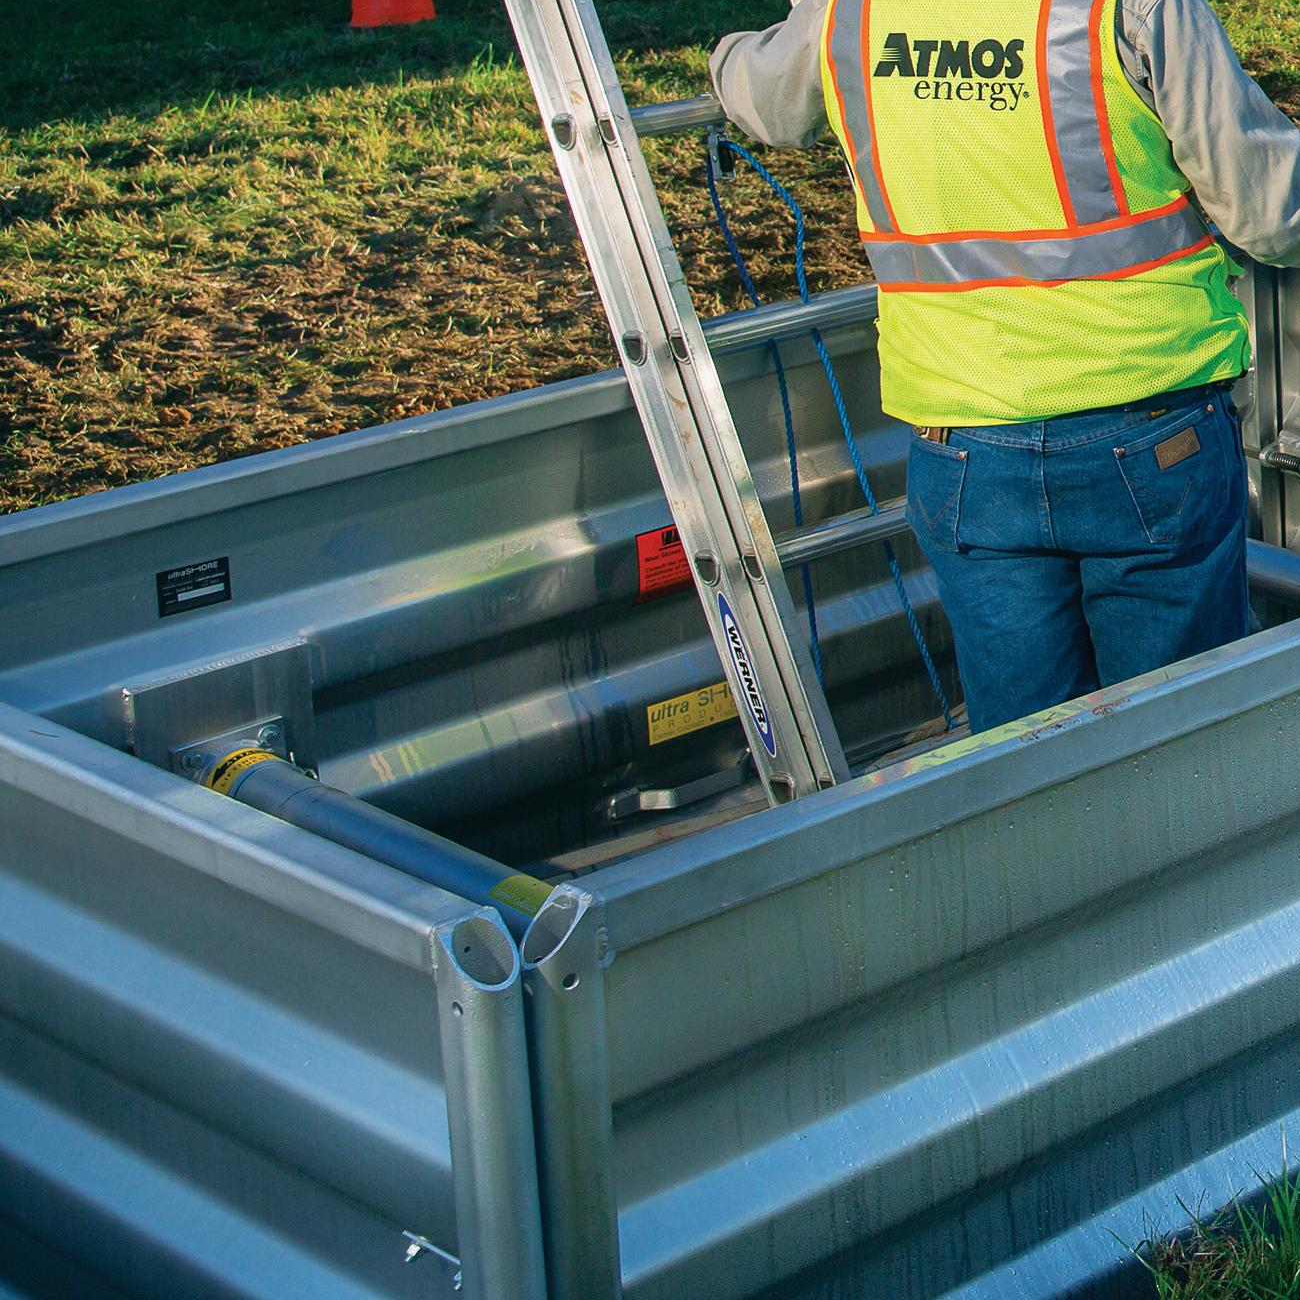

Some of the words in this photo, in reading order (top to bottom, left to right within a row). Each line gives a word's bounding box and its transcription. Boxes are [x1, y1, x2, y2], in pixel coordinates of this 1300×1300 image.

[873, 33, 1024, 79] ATMOS
[728, 625, 767, 725] WERNER
[651, 700, 689, 723] ultra
